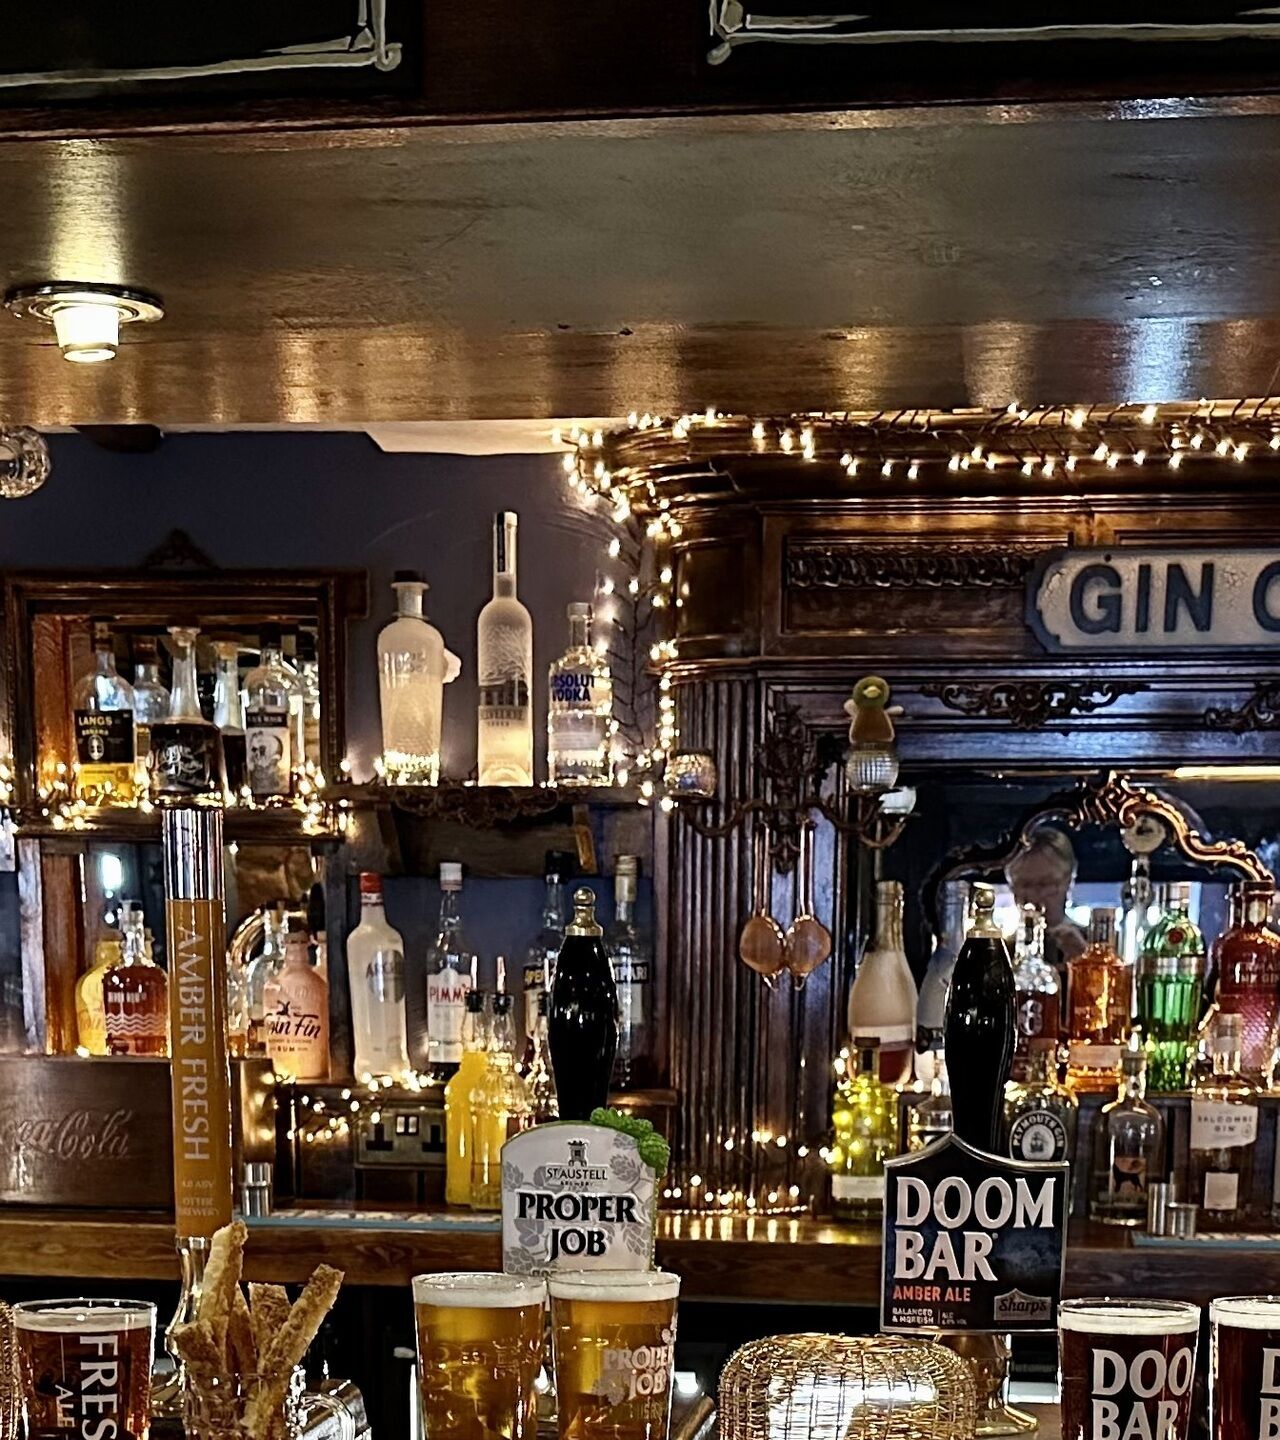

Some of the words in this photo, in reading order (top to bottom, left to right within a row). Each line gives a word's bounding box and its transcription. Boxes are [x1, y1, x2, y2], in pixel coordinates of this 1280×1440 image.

[1068, 561, 1213, 634] GIN
[177, 926, 206, 1046] AMBER
[181, 1057, 210, 1160] FRESH
[517, 1192, 638, 1224] PROPER
[895, 1176, 1056, 1229] DOOM
[549, 1228, 608, 1262] JOB
[893, 1231, 998, 1281] BAR
[892, 1285, 941, 1301] AMBER
[944, 1286, 971, 1302] ALE
[892, 1307, 933, 1317] BALANCED
[604, 1345, 675, 1372] PROPE
[1091, 1347, 1193, 1399] DOO
[55, 1384, 76, 1428] ALE
[628, 1371, 667, 1399] JOB
